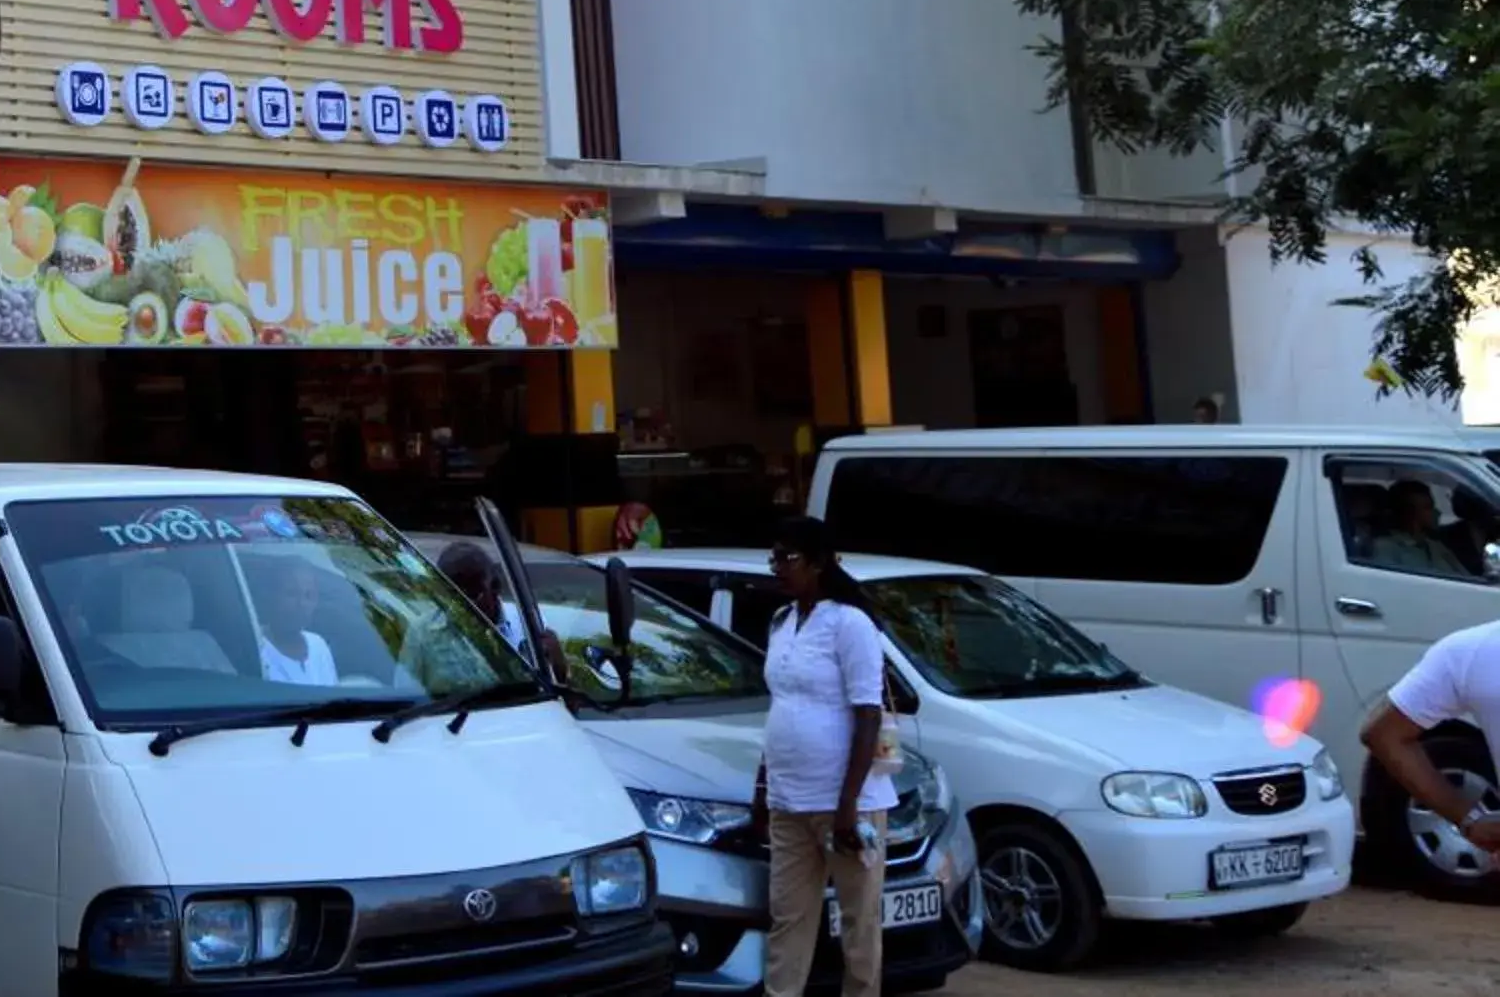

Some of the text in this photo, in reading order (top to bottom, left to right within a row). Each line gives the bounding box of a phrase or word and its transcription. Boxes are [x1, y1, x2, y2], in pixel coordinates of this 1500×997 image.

[381, 102, 394, 125] P
[238, 184, 464, 253] FRESH
[248, 236, 464, 325] Juice
[100, 517, 242, 546] TOYOTA
[893, 889, 940, 922] 2810
